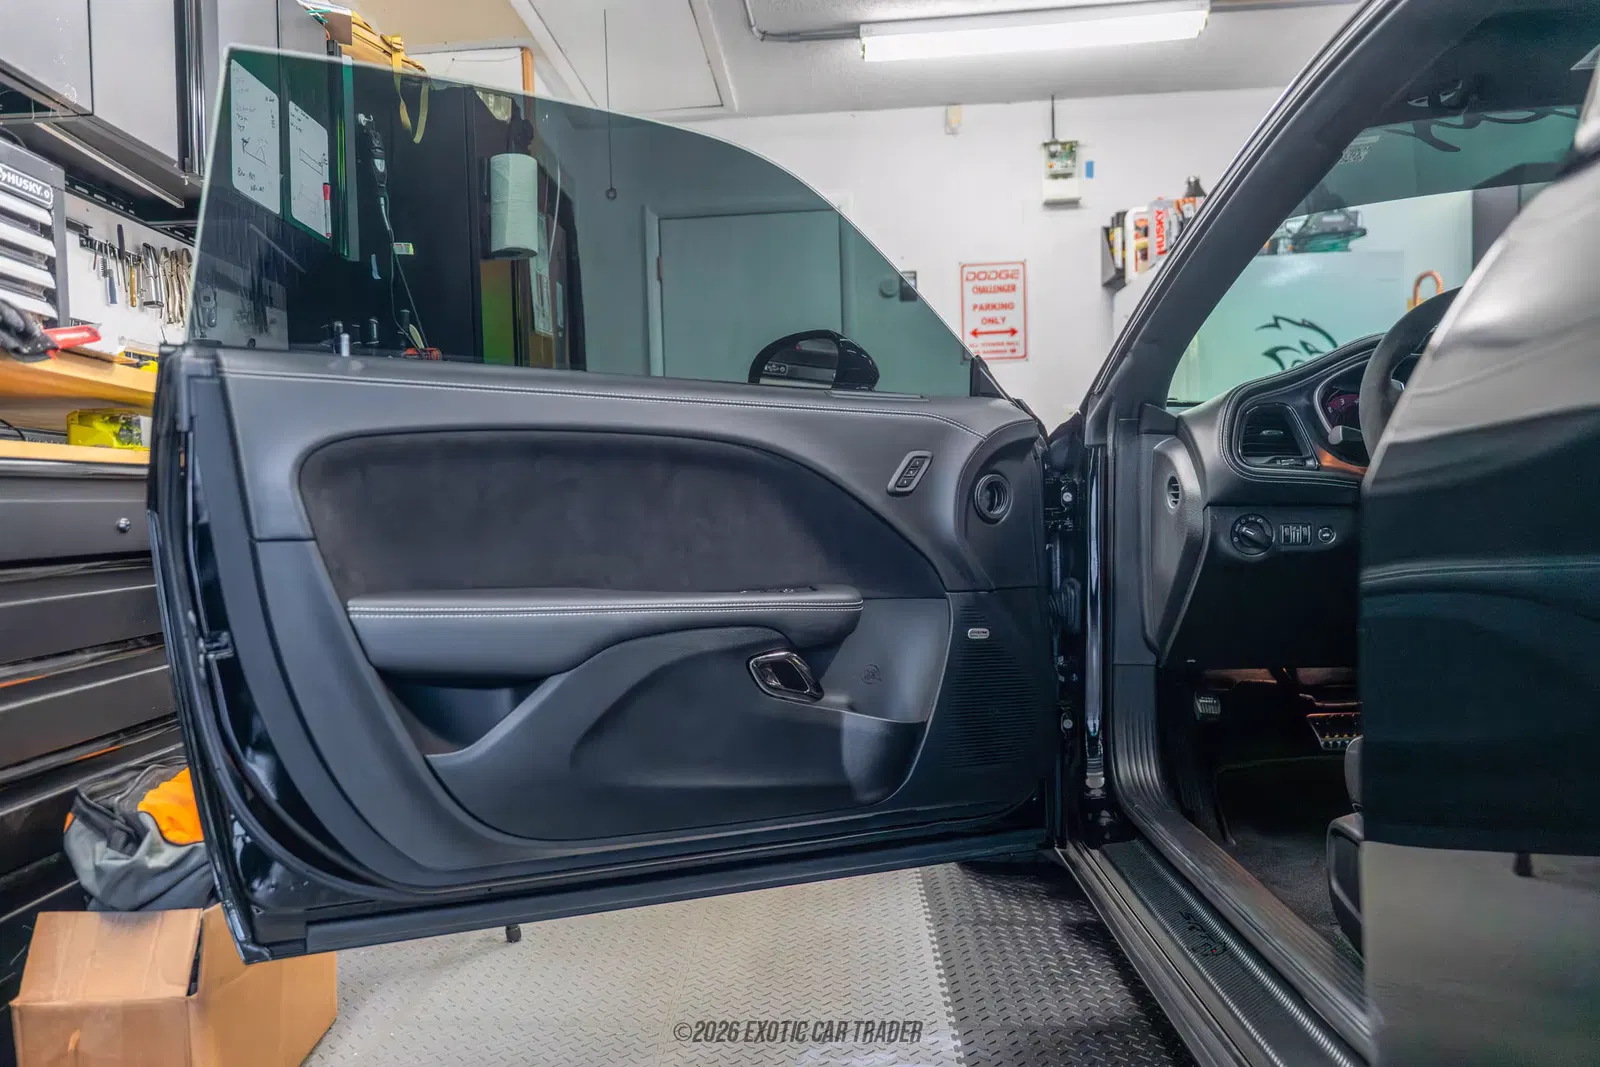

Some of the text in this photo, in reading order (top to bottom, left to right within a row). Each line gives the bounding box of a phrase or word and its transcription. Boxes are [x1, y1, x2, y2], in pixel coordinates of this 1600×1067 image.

[7, 171, 42, 196] HUSKY
[1154, 209, 1168, 256] HUSKY
[965, 269, 1020, 281] DODGE
[972, 284, 1017, 294] CHALLENGER
[972, 301, 1015, 311] PARKING
[981, 316, 1006, 325] ONLY
